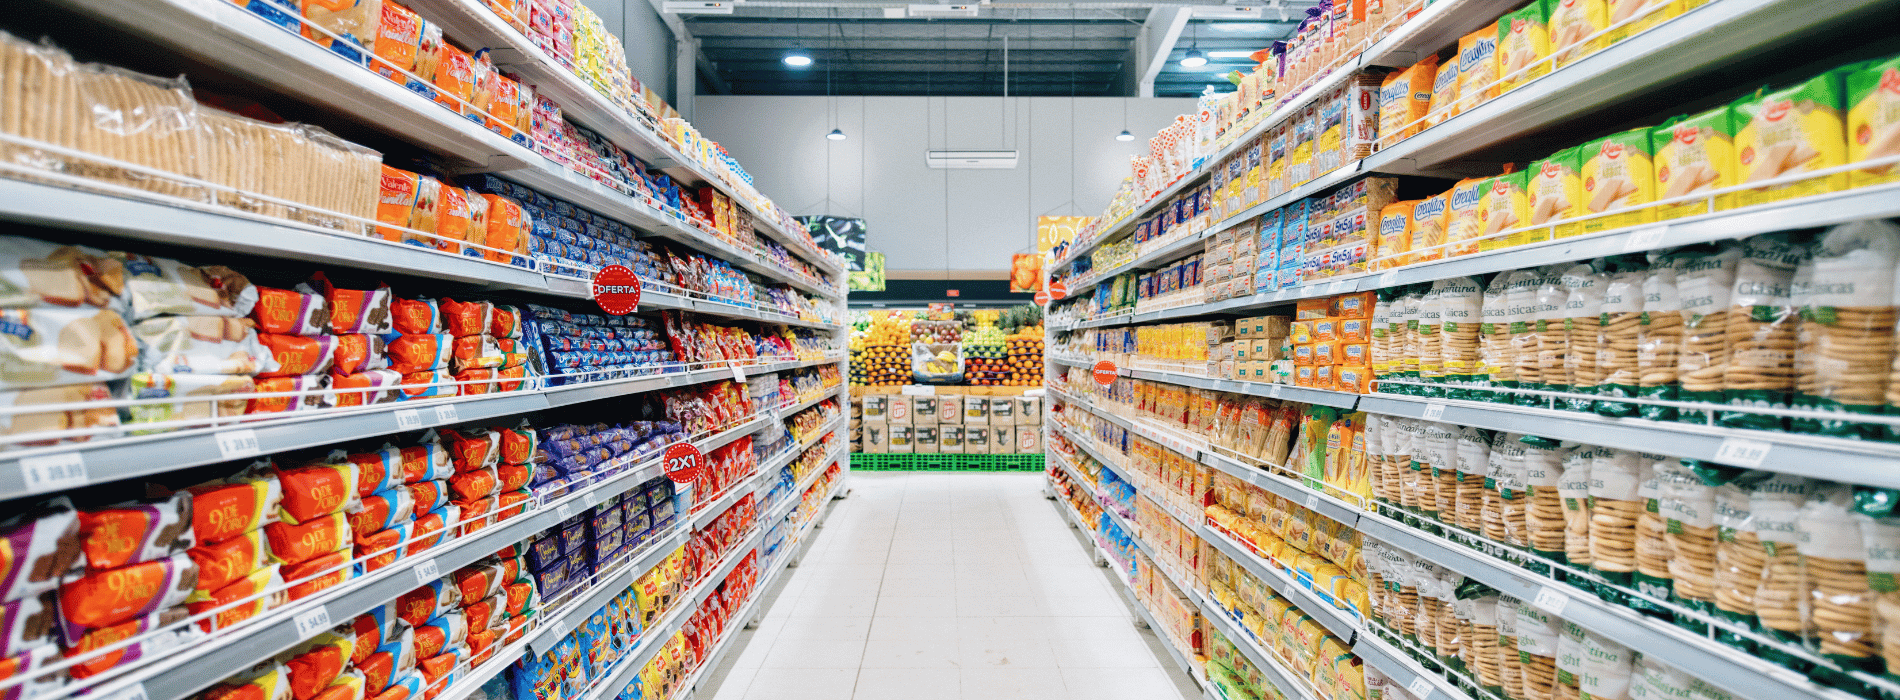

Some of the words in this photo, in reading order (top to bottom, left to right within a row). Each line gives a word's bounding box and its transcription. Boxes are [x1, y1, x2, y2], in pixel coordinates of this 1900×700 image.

[1460, 38, 1497, 73] Cerealitas
[1415, 197, 1447, 221] Cerealitas
[1380, 215, 1407, 235] Cerealitas
[598, 285, 636, 294] OFERTA
[421, 354, 433, 363] ORO
[669, 453, 697, 473] 2X1
[322, 495, 340, 509] ORO
